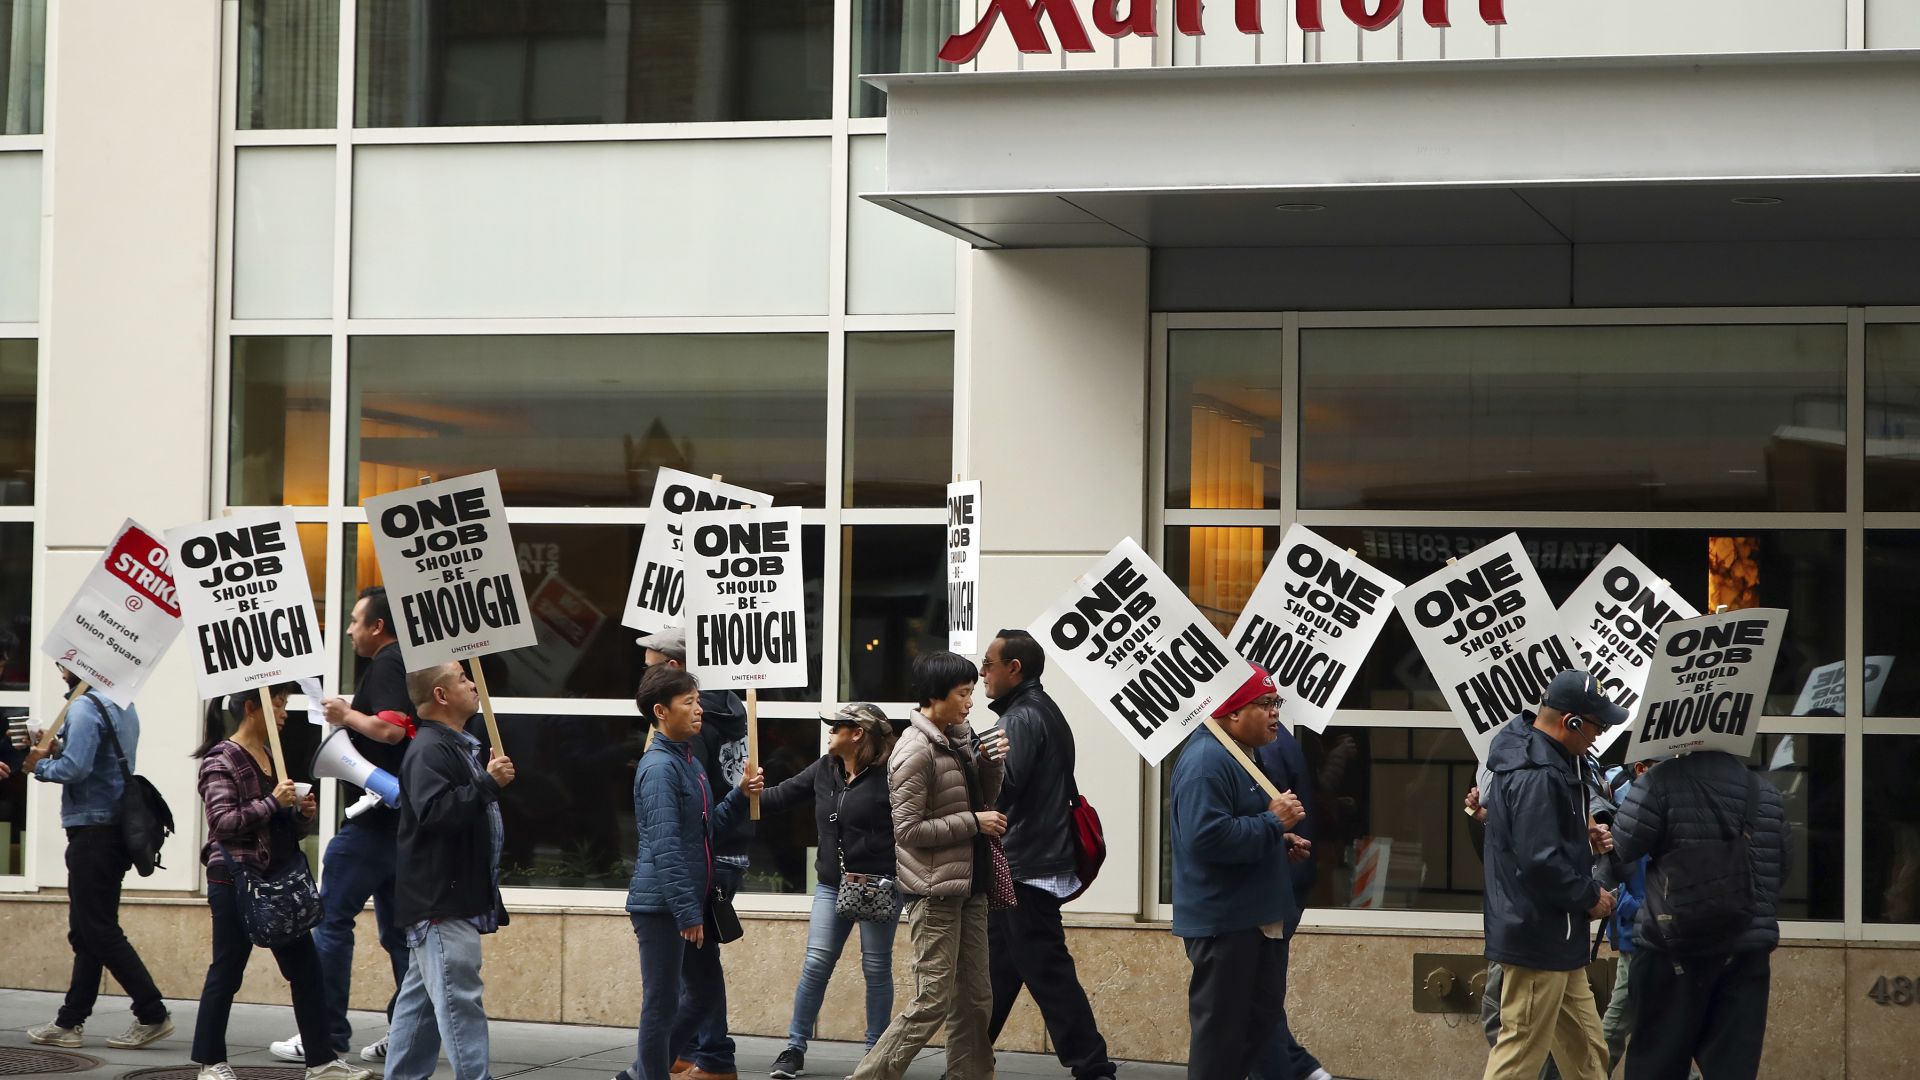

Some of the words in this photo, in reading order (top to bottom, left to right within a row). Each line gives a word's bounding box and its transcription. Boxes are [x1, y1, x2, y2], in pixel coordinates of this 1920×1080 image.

[381, 487, 490, 538] ONE
[948, 495, 974, 527] ONE
[181, 521, 286, 568] ONE
[401, 523, 488, 558] JOB
[694, 521, 789, 557] ONE
[949, 528, 970, 548] JOB
[199, 556, 282, 588] JOB
[416, 548, 483, 572] SHOULD
[442, 567, 464, 583] BE
[706, 556, 784, 579] JOB
[212, 579, 277, 602] SHOULD
[637, 562, 685, 617] ENO
[717, 580, 776, 594] SHOULD
[1287, 544, 1385, 615] ONE
[1414, 552, 1523, 628] ONE
[125, 595, 143, 612] @
[238, 598, 259, 612] BE
[401, 574, 520, 647] ENOUGH
[738, 597, 757, 609] BE
[1051, 557, 1148, 650] ONE
[1284, 581, 1361, 629] JOB
[1284, 599, 1342, 638] SHOULD
[1443, 590, 1526, 645] JOB
[76, 615, 105, 640] Union
[106, 637, 142, 665] Square
[98, 610, 139, 642] Marriott
[198, 605, 312, 674] ENOUGH
[697, 611, 797, 666] ENOUGH
[1086, 591, 1156, 662] JOB
[1105, 616, 1161, 669] SHOULD
[1295, 623, 1316, 642] BE
[1460, 615, 1526, 657] SHOULD
[1590, 619, 1643, 667] SHOULD
[1666, 620, 1769, 657] ONE
[1133, 642, 1156, 665] BE
[1235, 614, 1346, 708] ENOUGH
[1489, 640, 1513, 660] BE
[1597, 644, 1617, 665] BE
[1671, 647, 1752, 673] JOB
[1110, 623, 1229, 740] ENOUGH
[1676, 666, 1739, 685] SHOULD
[1694, 681, 1713, 694] BE
[1640, 691, 1754, 743] ENOUGH
[1868, 975, 1920, 1007] 48
